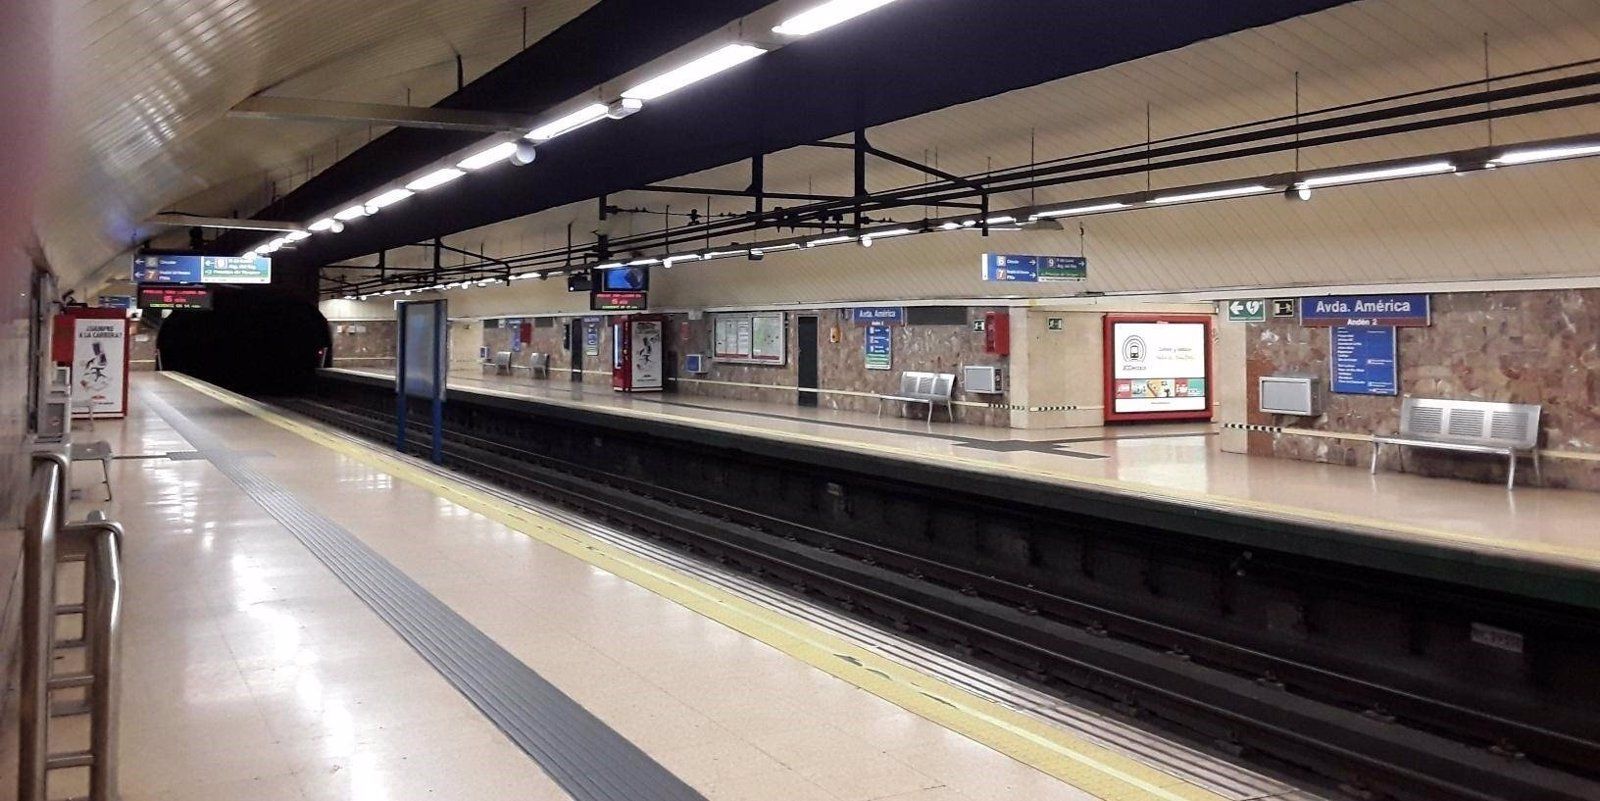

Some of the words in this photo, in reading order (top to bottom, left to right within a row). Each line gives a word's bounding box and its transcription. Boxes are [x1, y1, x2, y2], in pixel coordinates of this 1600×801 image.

[1315, 300, 1351, 313] Avda.
[1354, 299, 1411, 313] América
[874, 309, 896, 317] América
[1347, 318, 1370, 326] Andén
[1372, 318, 1378, 326] 2
